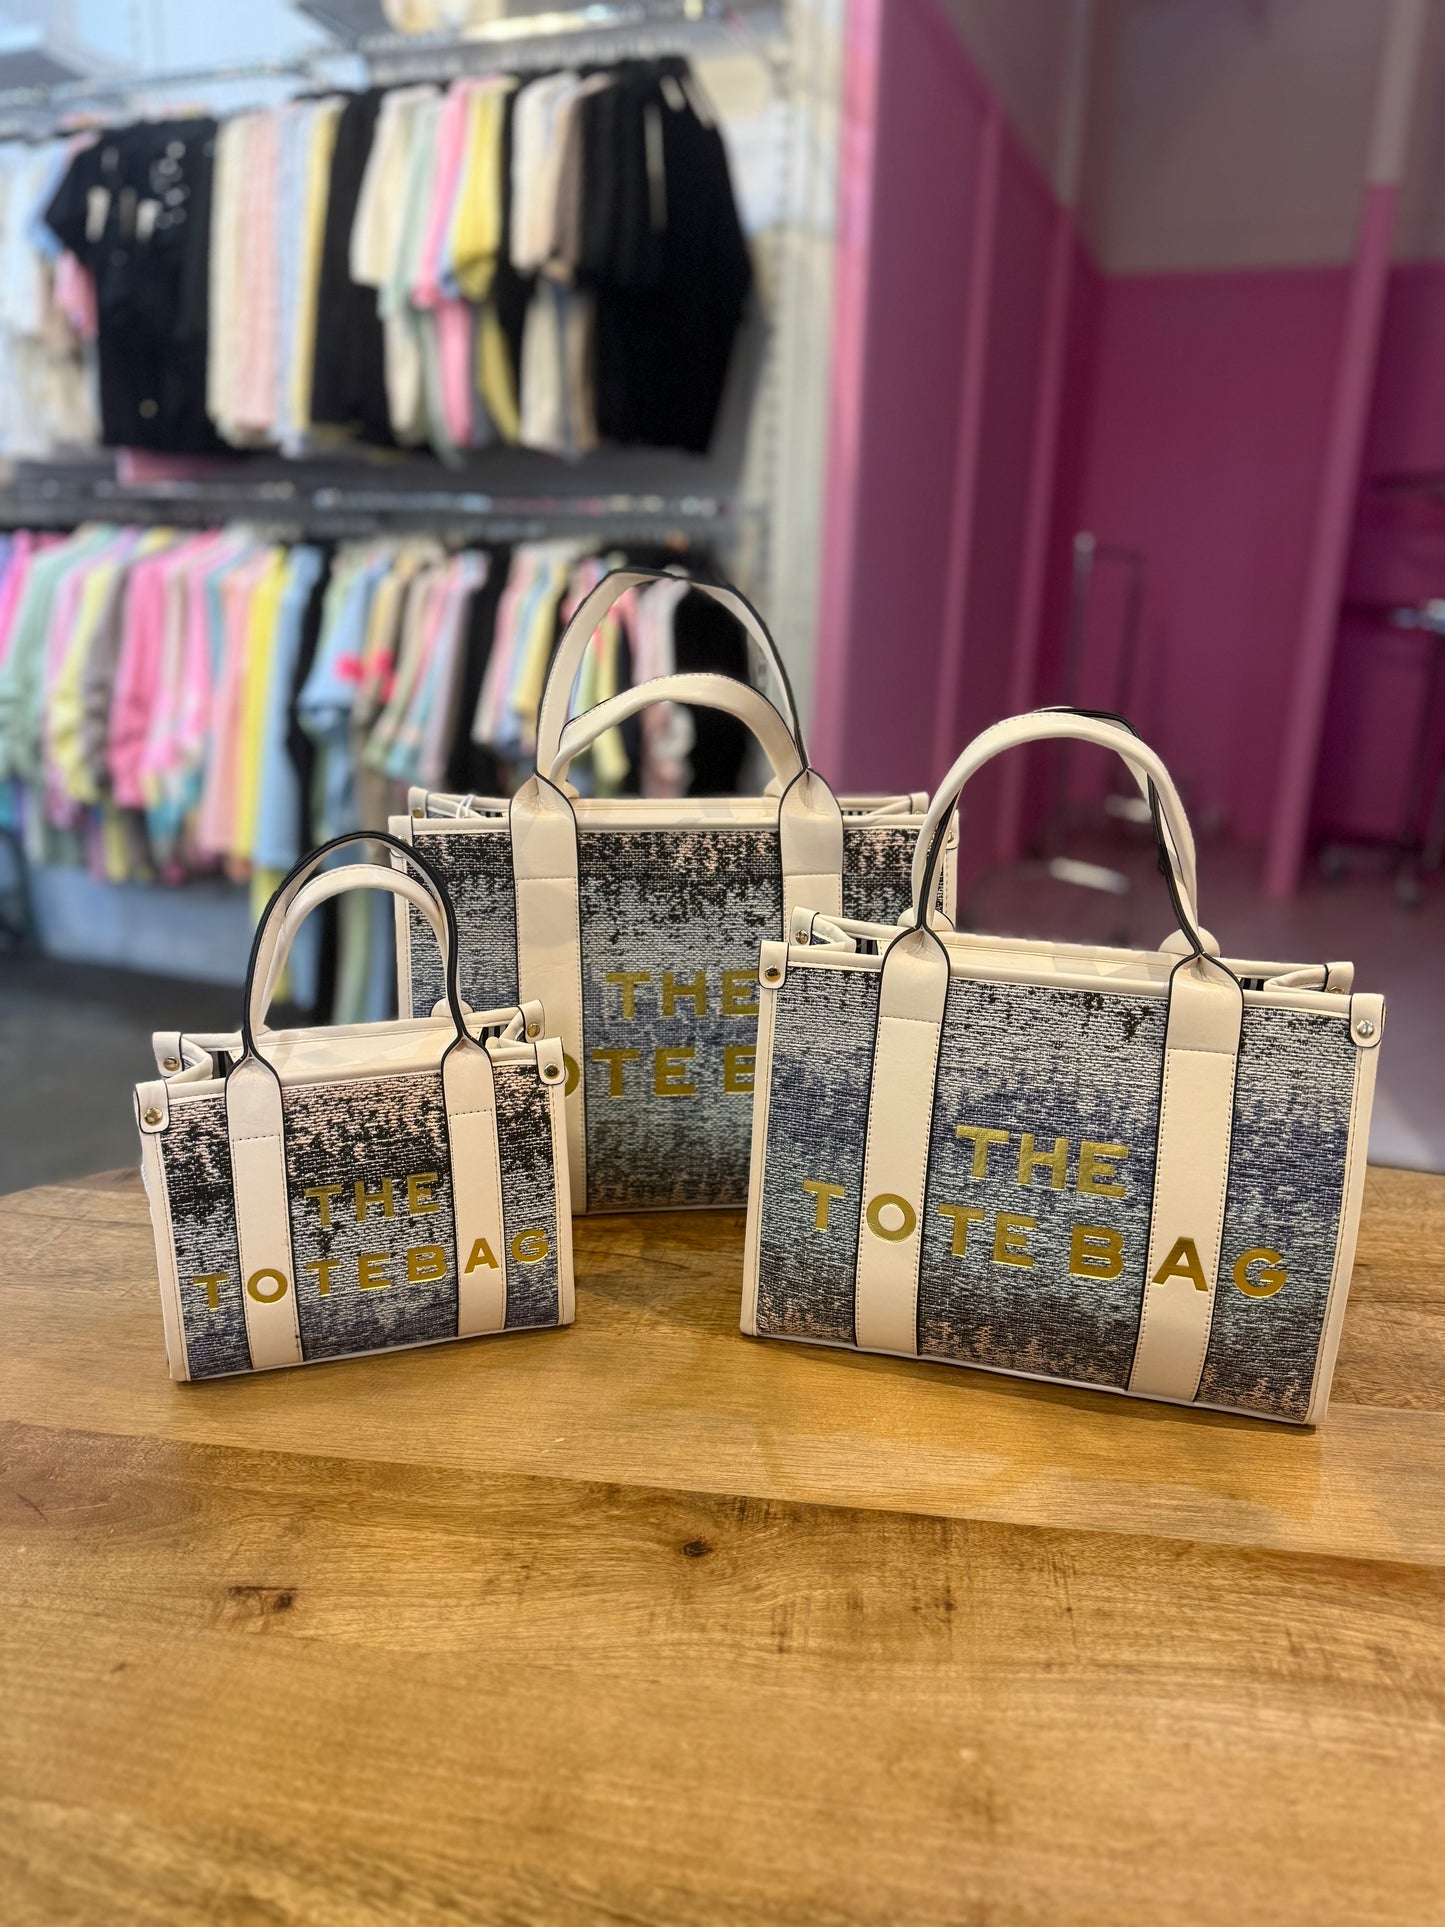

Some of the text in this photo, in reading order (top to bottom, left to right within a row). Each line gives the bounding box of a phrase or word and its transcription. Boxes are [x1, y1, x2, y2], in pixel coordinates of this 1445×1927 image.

[605, 970, 759, 1021] THE
[955, 1124, 1129, 1199] THE
[304, 1172, 442, 1228] THE
[803, 1179, 1289, 1299] TOTE BAG
